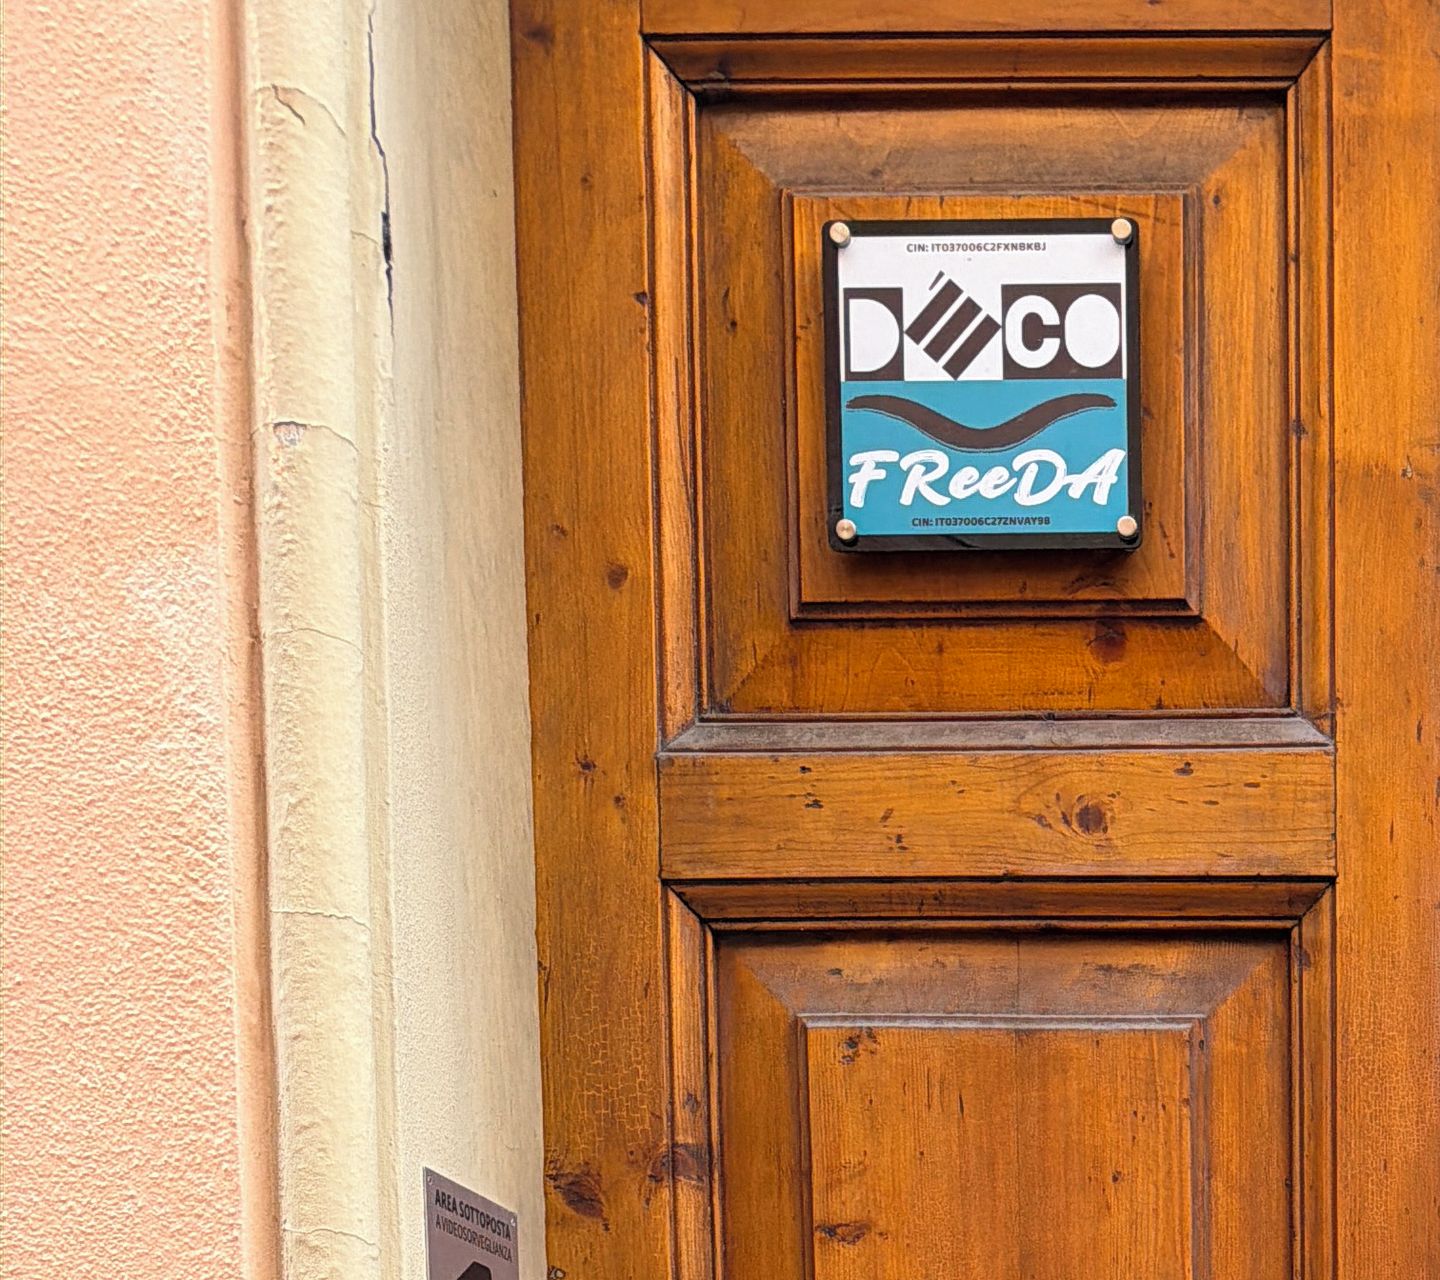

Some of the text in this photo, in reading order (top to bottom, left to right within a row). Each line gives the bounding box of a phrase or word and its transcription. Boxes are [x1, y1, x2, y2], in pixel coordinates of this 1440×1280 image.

[906, 243, 929, 253] CIN:
[911, 516, 934, 527] CIN:
[435, 1188, 512, 1241] AREA SOTTOPOSTA
[435, 1214, 513, 1263] A VIDEOSORVEGLIANZA
